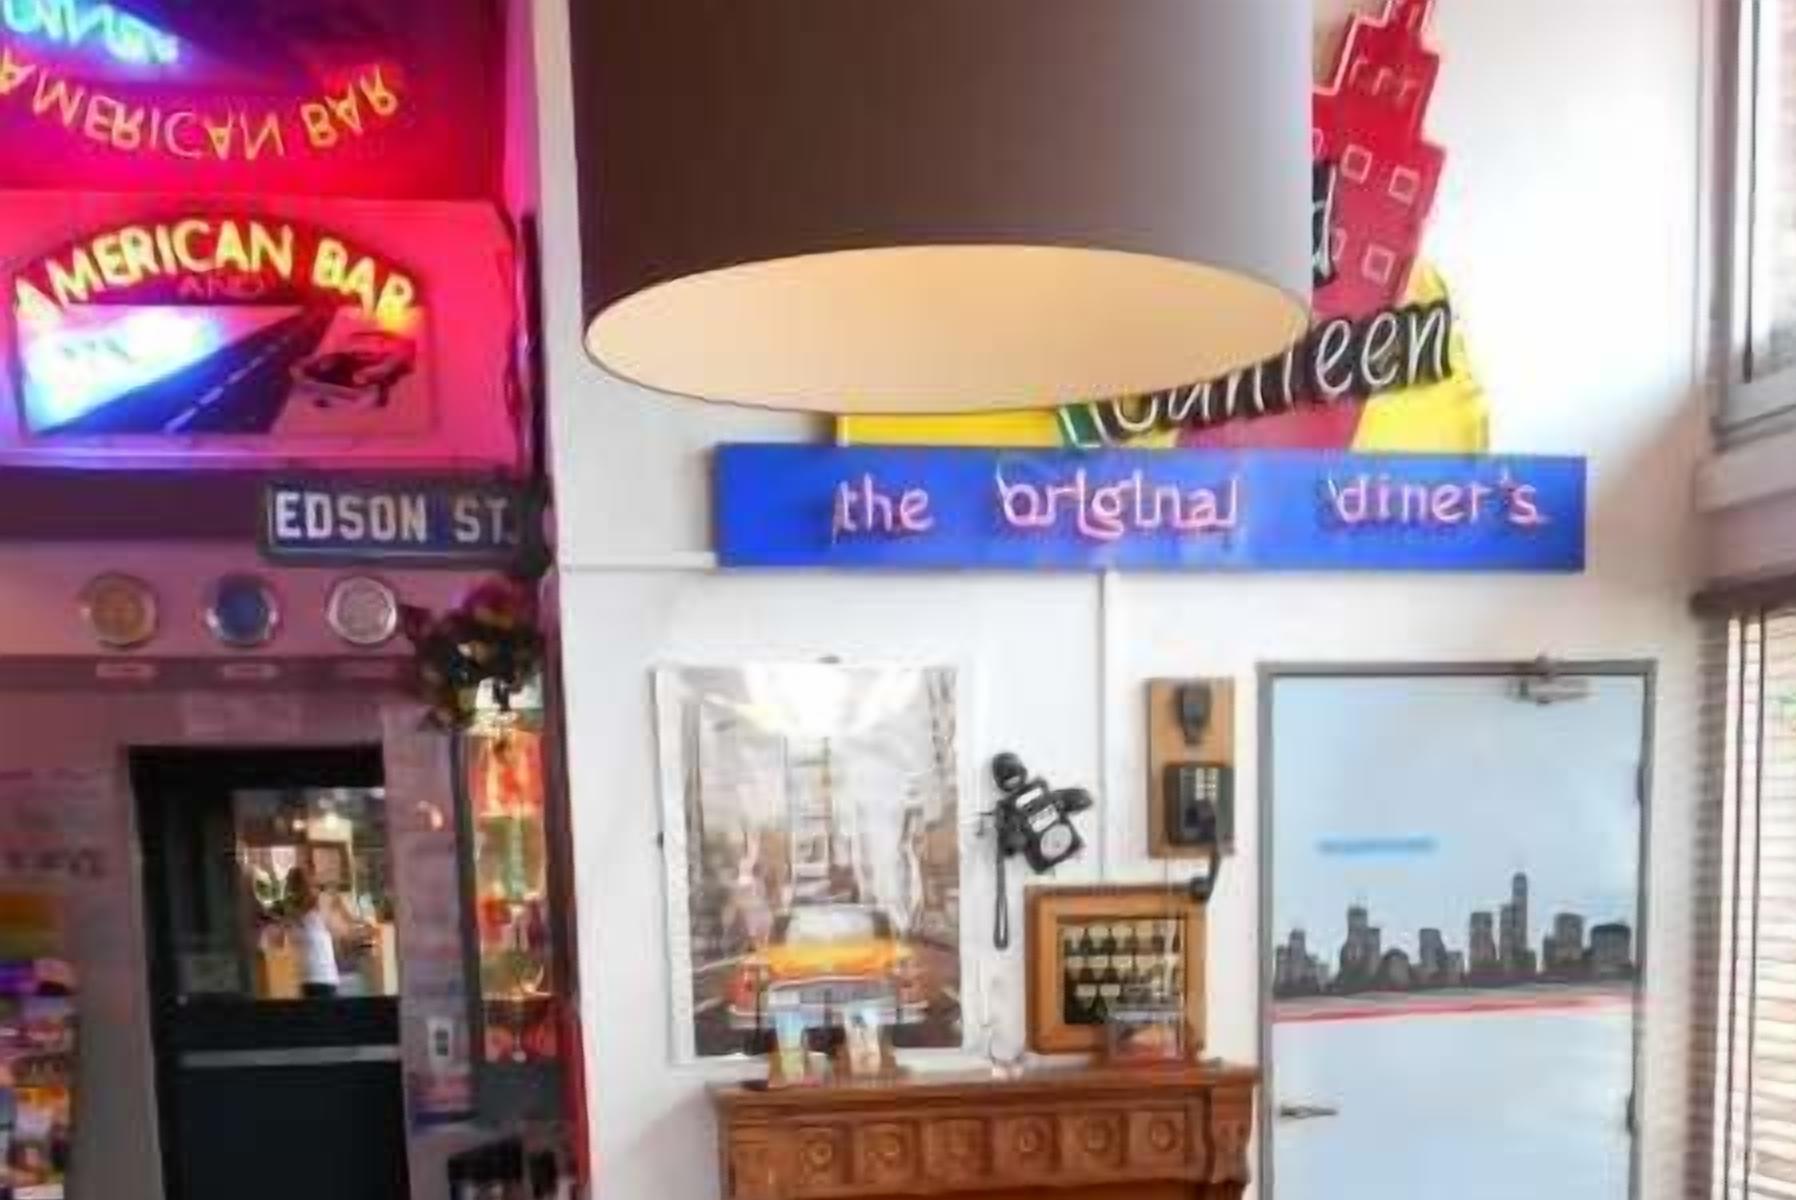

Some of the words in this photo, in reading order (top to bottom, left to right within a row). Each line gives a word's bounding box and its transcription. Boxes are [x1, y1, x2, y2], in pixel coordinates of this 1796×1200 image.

[15, 218, 294, 322] AMERICAN
[312, 237, 415, 335] BAR
[275, 490, 428, 542] EDSON
[833, 474, 934, 540] the
[996, 467, 1239, 540] original
[1326, 467, 1548, 526] diner's
